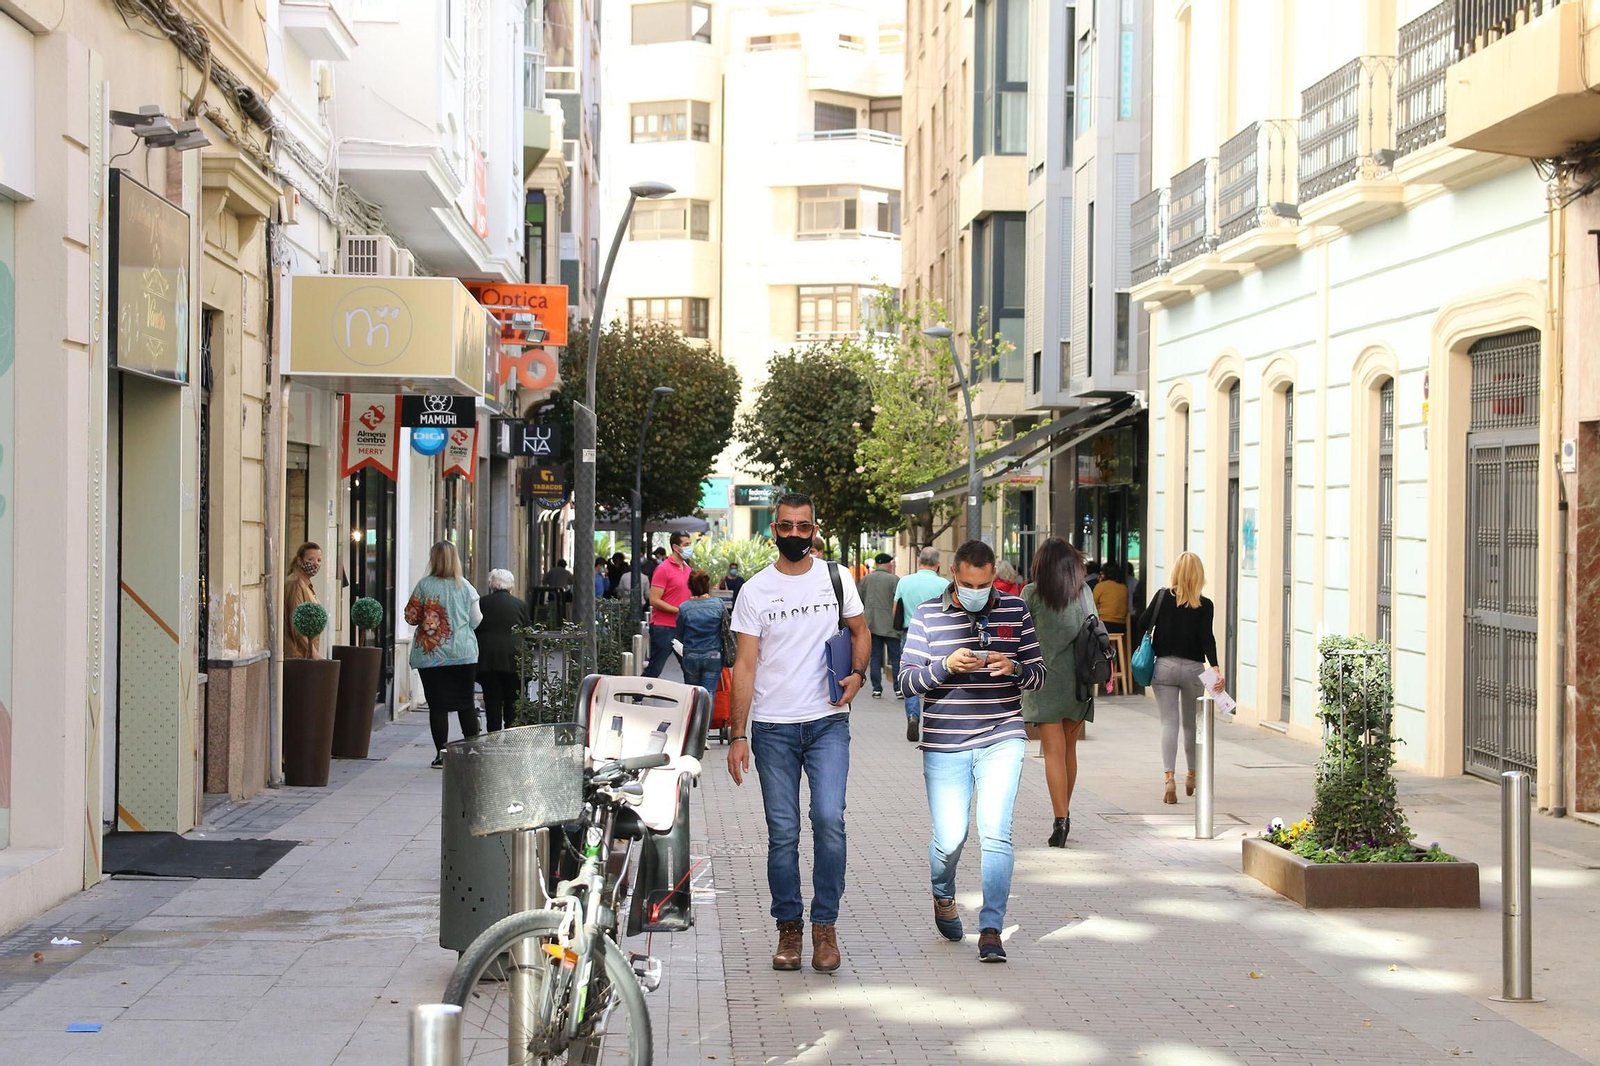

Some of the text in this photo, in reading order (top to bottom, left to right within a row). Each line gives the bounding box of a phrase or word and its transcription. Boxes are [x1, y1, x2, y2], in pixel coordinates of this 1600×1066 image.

[420, 414, 457, 425] MAMUHI
[356, 436, 386, 444] centro
[413, 432, 445, 440] DIGI
[358, 447, 384, 455] MERRY
[768, 603, 838, 621] HACKETT
